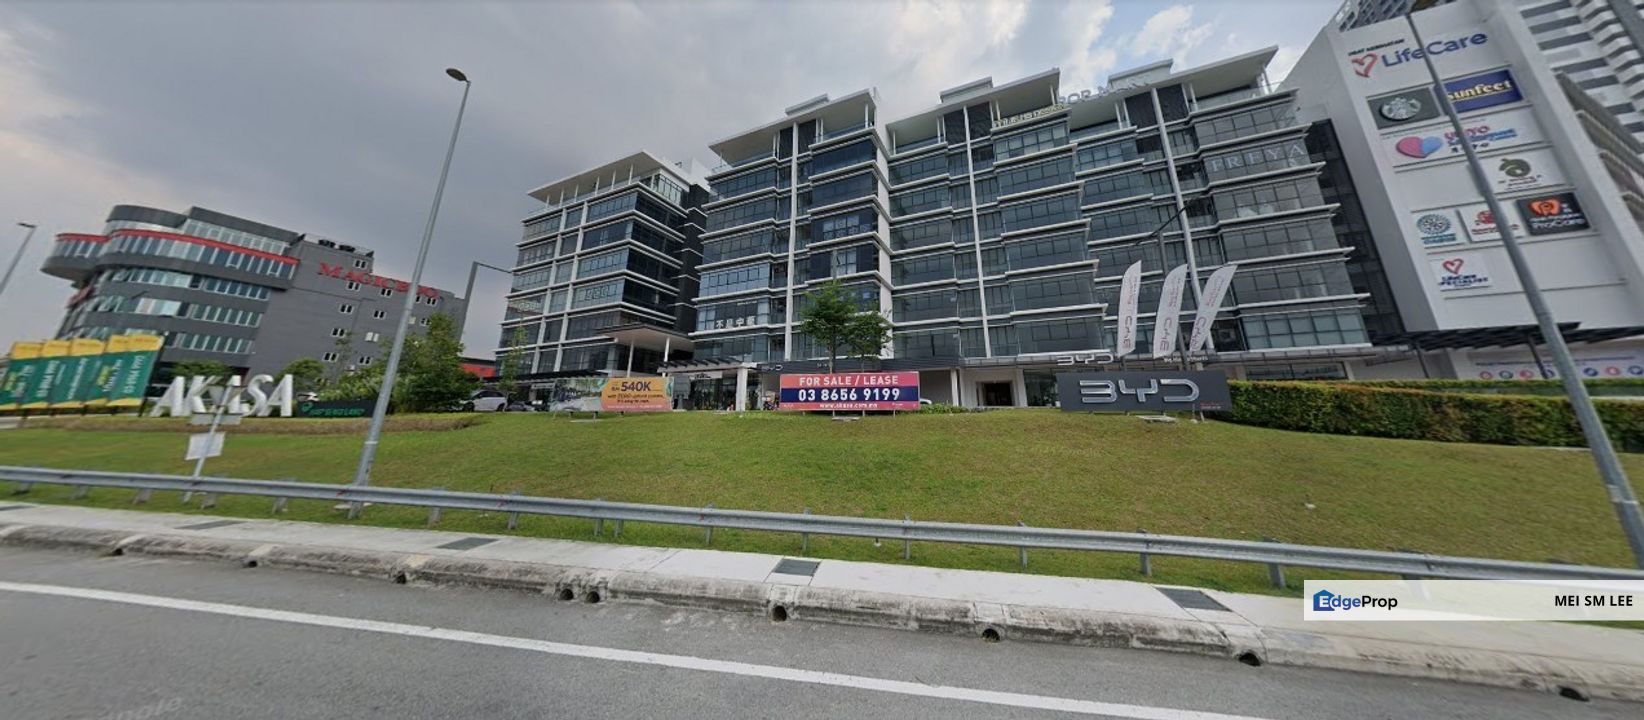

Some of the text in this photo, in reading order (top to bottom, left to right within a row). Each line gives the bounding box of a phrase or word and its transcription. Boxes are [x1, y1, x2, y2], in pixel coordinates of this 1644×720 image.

[1381, 33, 1488, 67] LifeCare
[1210, 144, 1305, 173] FREYA
[1057, 353, 1114, 366] BYD
[620, 381, 652, 392] 540K
[799, 376, 820, 386] FOR
[823, 376, 851, 386] SALE
[863, 375, 899, 386] LEASE
[798, 388, 900, 402] 03 8656 9199
[1079, 378, 1200, 403] BYD
